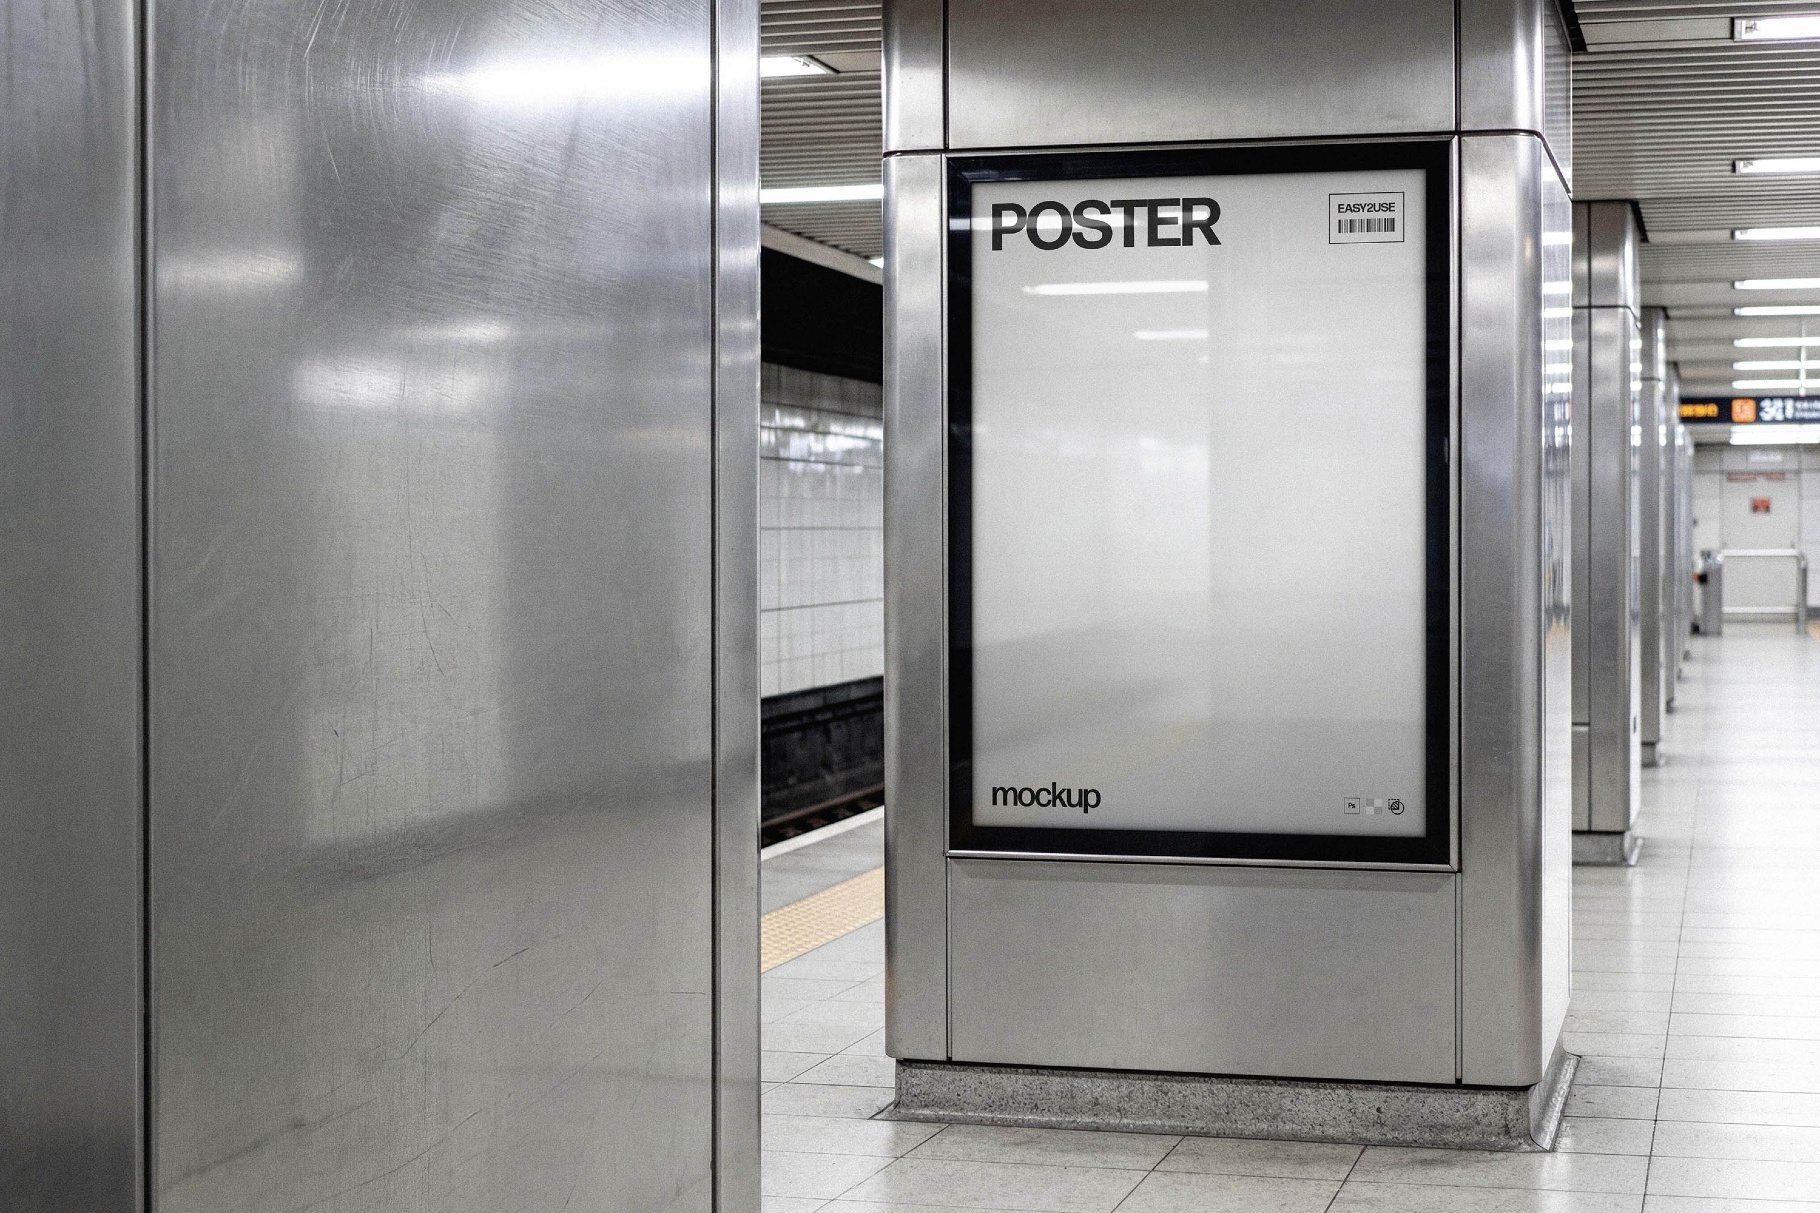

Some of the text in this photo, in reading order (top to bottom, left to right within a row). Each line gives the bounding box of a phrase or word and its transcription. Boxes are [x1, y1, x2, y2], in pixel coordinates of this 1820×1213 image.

[1338, 202, 1396, 213] EASY2USE
[992, 197, 1222, 251] POSTER
[992, 782, 1102, 814] mockup
